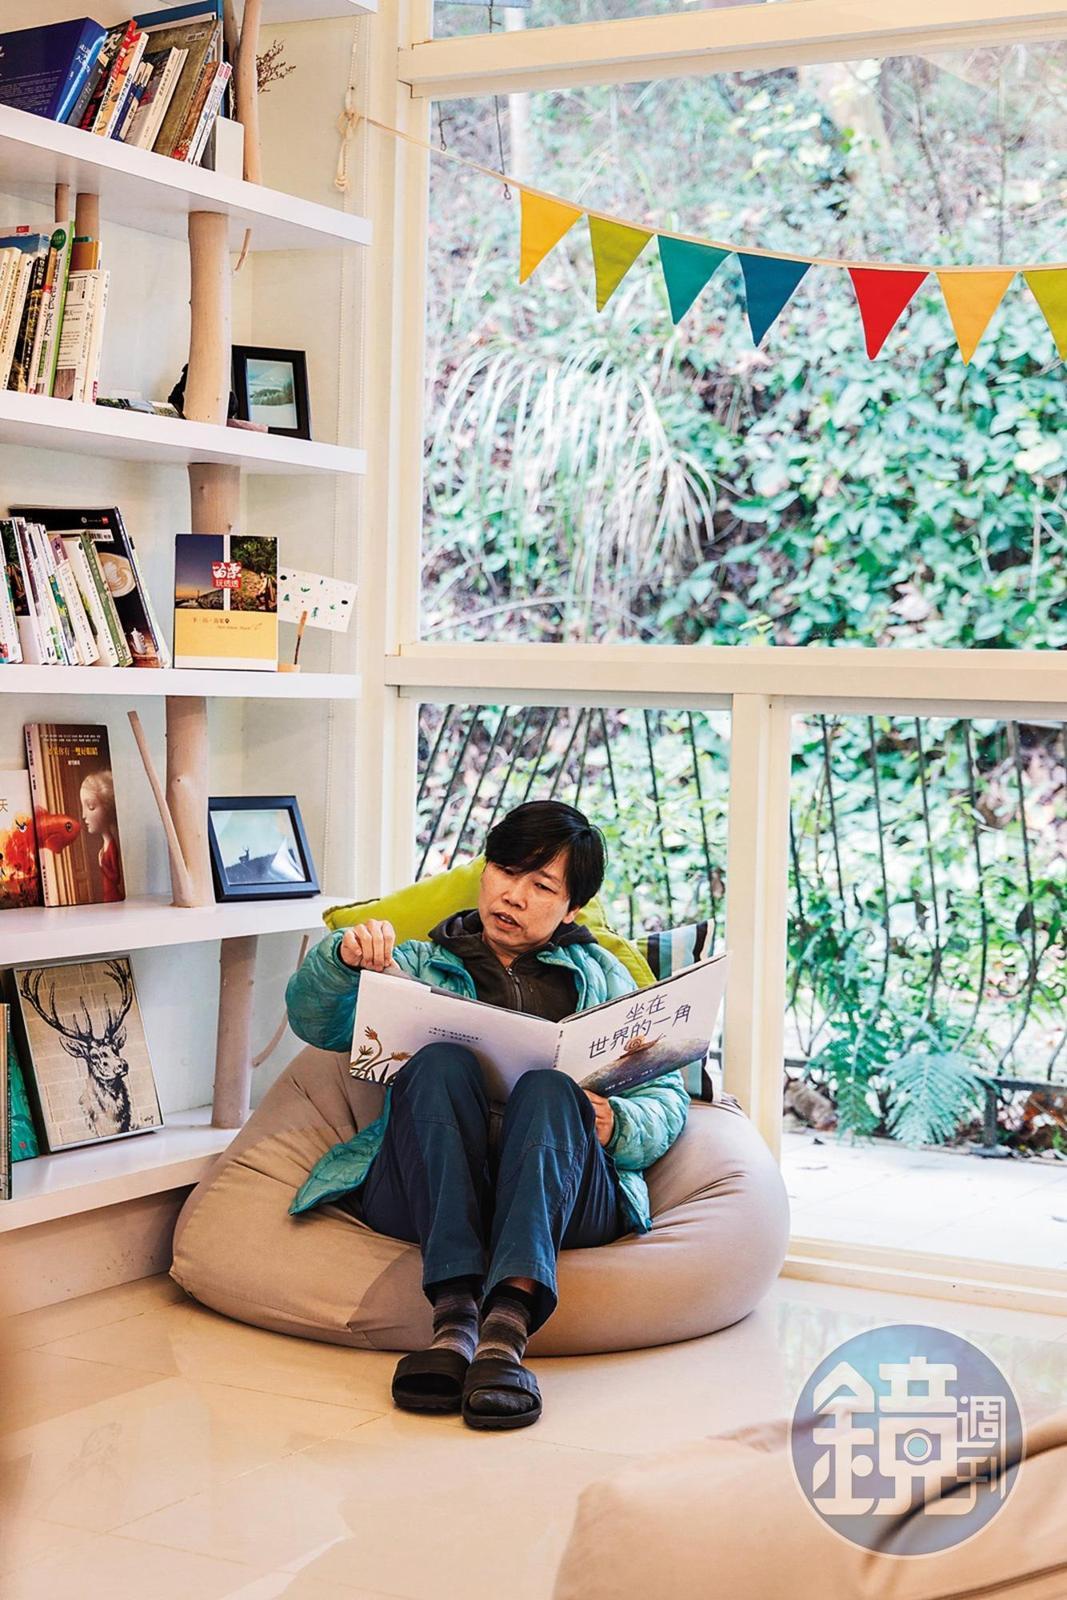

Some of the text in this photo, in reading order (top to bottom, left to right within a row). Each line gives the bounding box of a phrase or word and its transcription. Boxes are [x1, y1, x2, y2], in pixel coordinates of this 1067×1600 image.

[624, 993, 668, 1025] 坐在
[588, 1004, 691, 1059] 世界的一角
